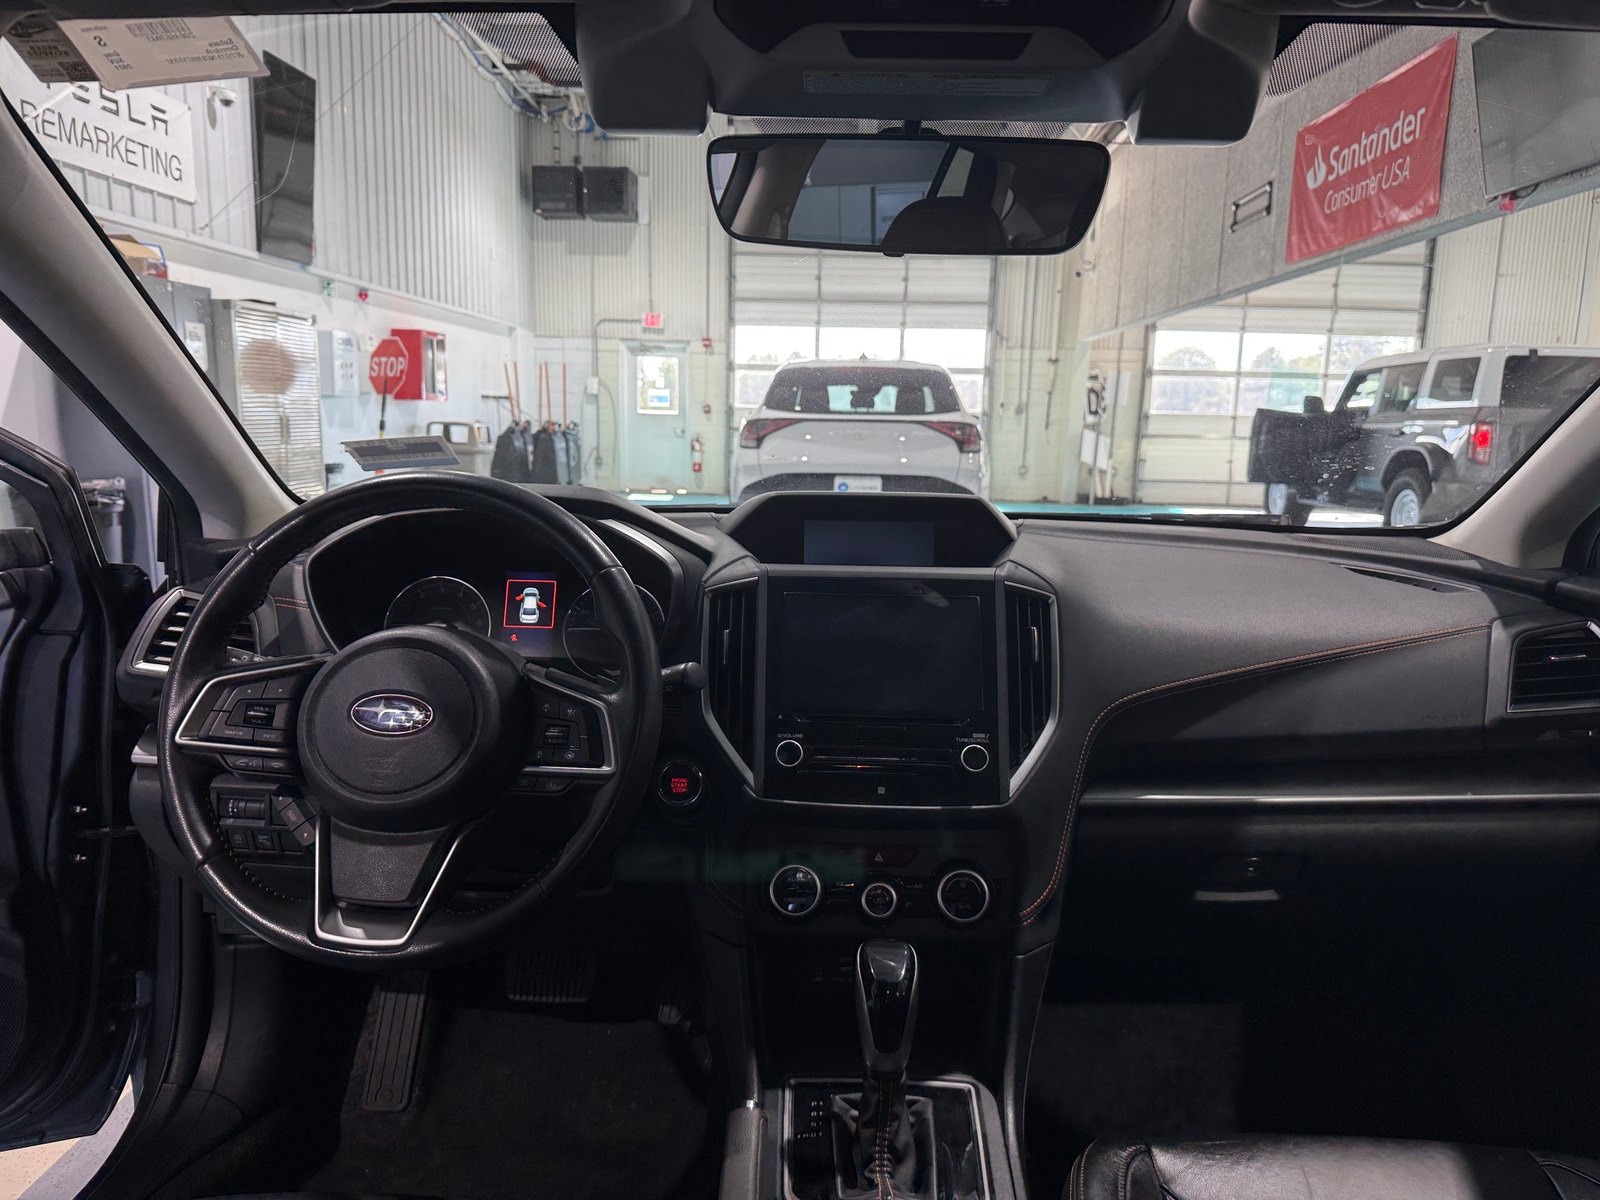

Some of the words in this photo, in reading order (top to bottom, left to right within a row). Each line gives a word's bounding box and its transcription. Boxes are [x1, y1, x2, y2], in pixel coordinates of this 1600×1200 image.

[19, 98, 183, 182] REMARKETING
[1328, 106, 1426, 182] Santander
[1323, 171, 1382, 215] Consumer
[1381, 156, 1411, 191] USA
[370, 356, 406, 377] STOP
